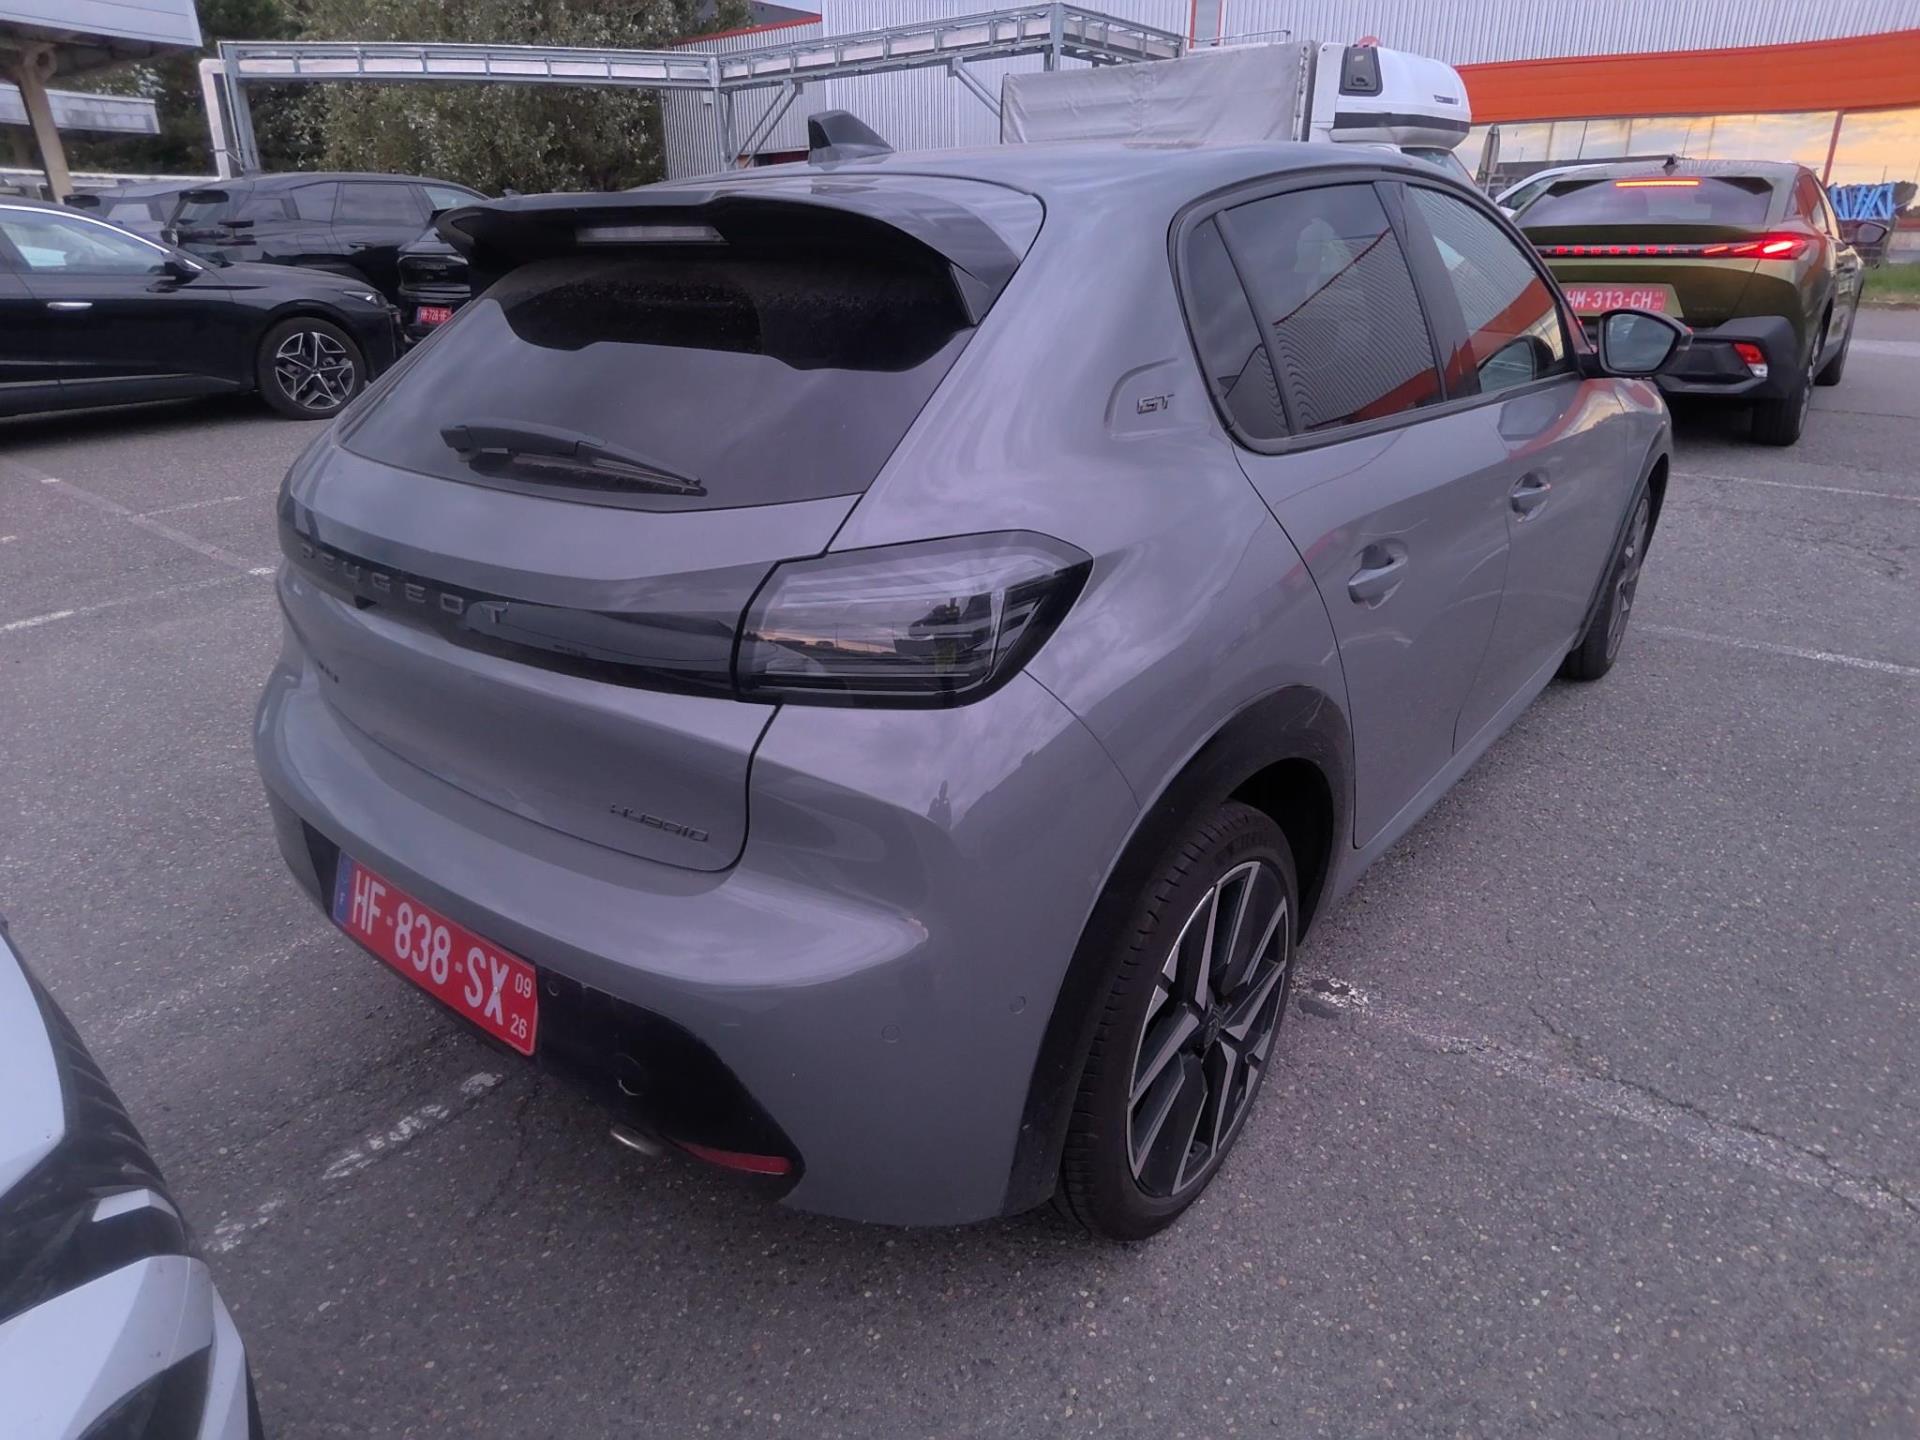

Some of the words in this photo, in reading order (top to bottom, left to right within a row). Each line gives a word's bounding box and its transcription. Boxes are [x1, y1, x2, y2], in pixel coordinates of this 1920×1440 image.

[1137, 393, 1175, 414] GT
[301, 543, 508, 624] PEUGEOT
[352, 869, 509, 1026] HF-838-SX
[515, 972, 532, 999] 09
[510, 1013, 527, 1040] 26
